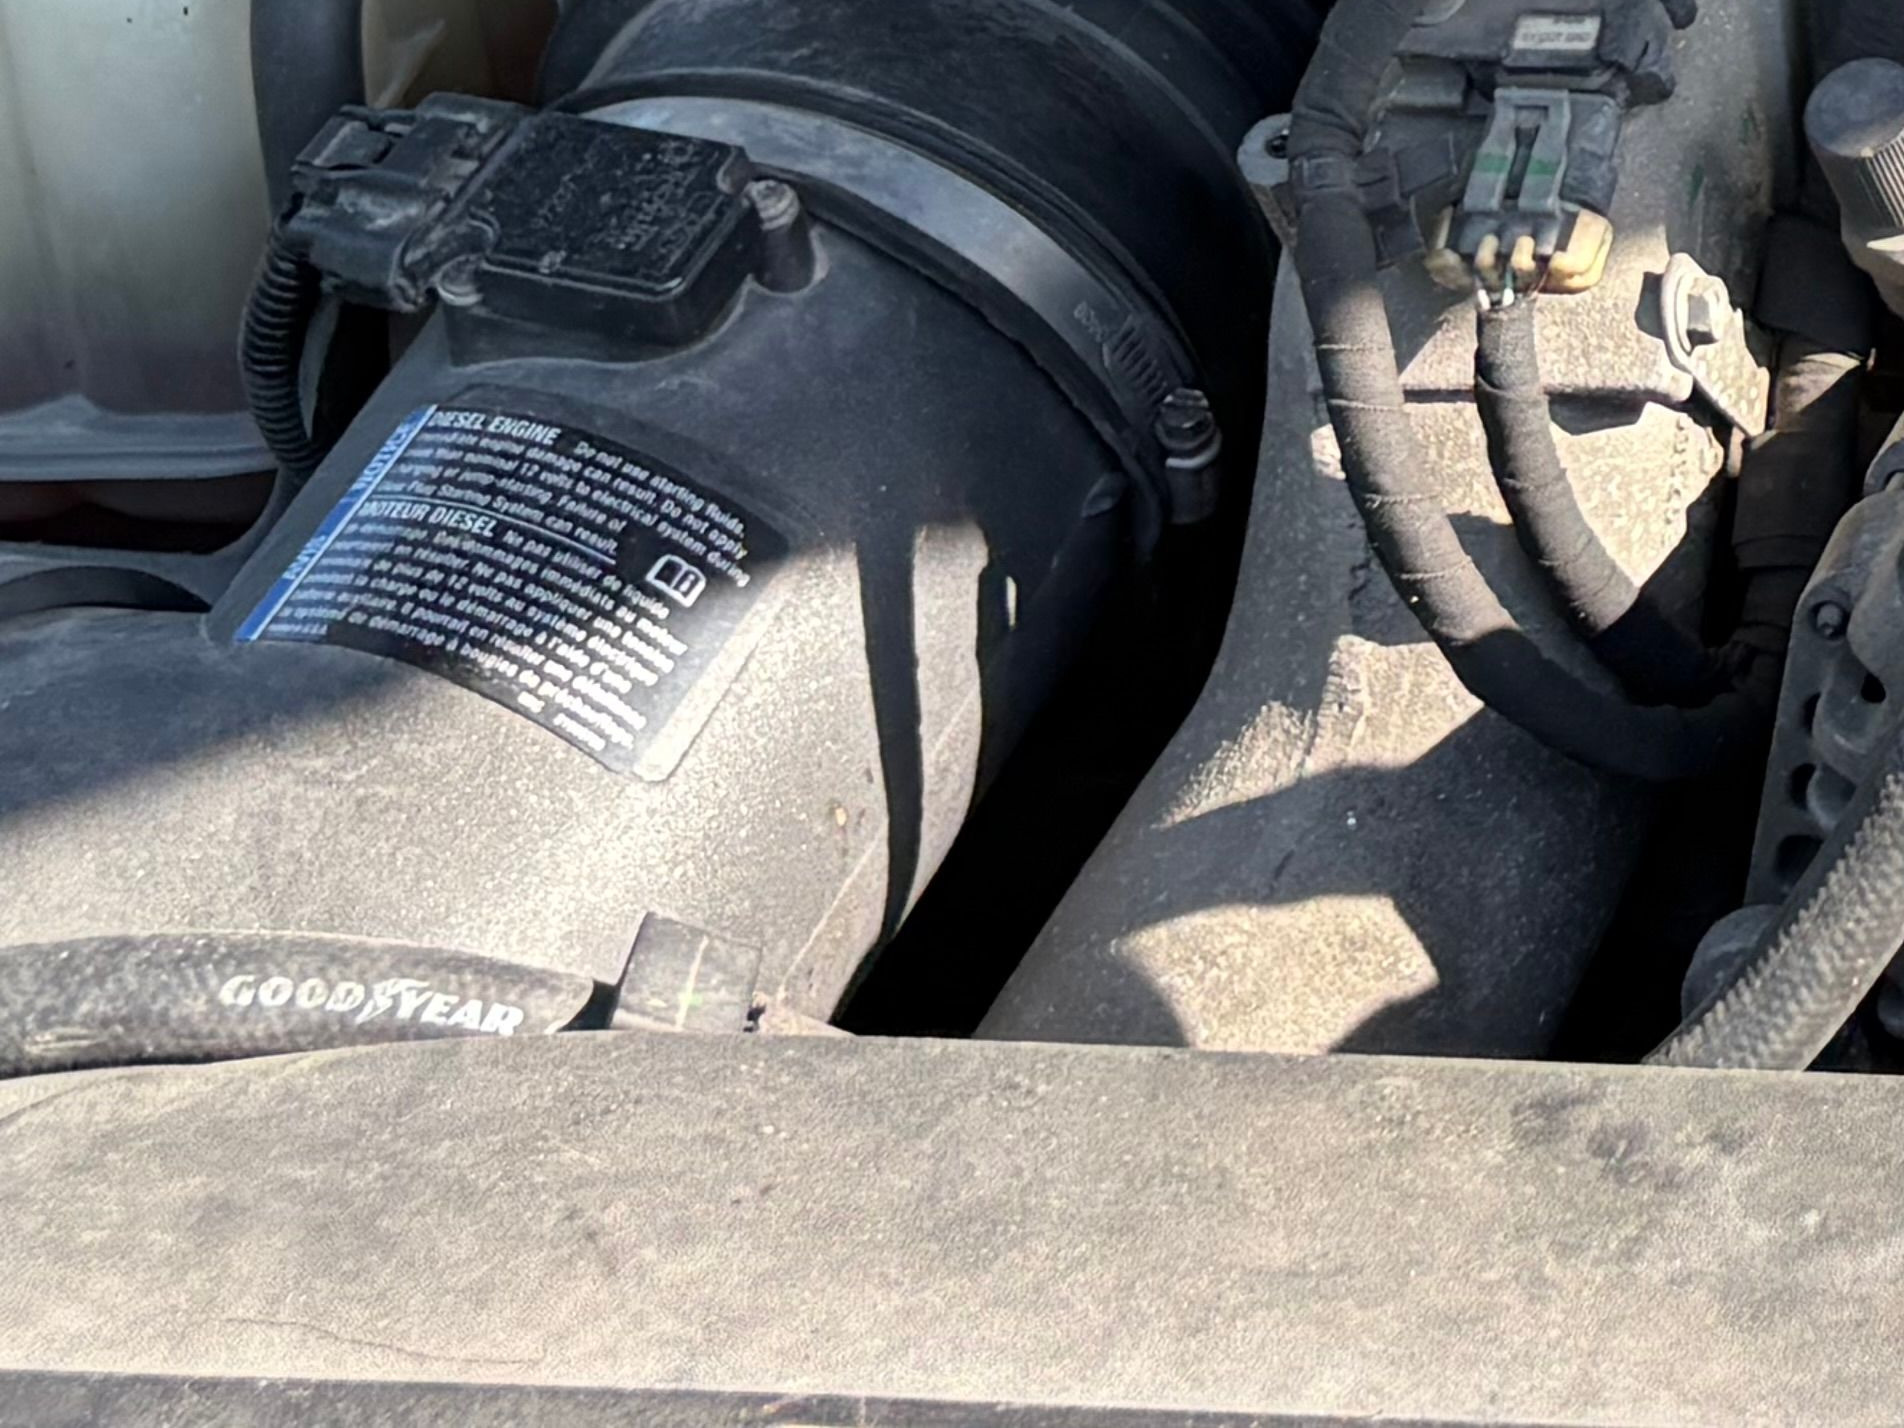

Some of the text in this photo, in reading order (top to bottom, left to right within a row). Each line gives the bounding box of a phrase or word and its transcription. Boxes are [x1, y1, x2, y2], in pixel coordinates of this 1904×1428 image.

[427, 409, 487, 428] DIESEL
[486, 416, 561, 443] ENGINE
[572, 440, 598, 458] Do
[594, 449, 624, 467] not
[620, 461, 650, 481] use
[647, 473, 706, 512] starting
[435, 483, 493, 505] Starting
[490, 495, 547, 519] System
[543, 514, 575, 532] can
[572, 524, 623, 554] result.
[457, 466, 554, 502] jump-starting.
[555, 493, 611, 523] Failure
[605, 516, 628, 531] of
[463, 450, 519, 470] nominal
[518, 461, 540, 476] 12
[537, 469, 575, 489] volts
[573, 480, 594, 494] to
[589, 485, 659, 527] electrical
[653, 521, 709, 555] system
[704, 546, 753, 588] during
[476, 437, 525, 454] engine
[524, 445, 582, 472] damage
[582, 465, 612, 481] can
[610, 475, 661, 506] result.
[657, 499, 684, 518] Do
[680, 511, 711, 532] not
[704, 526, 750, 561] apply
[356, 500, 672, 620] MOTEUR DIESEL Ne pas utiliser de liquide
[471, 559, 496, 577] Ne
[492, 571, 524, 588] pas
[522, 578, 596, 622] appliquer
[539, 562, 619, 610] immédiats
[614, 605, 639, 623] au
[367, 613, 448, 647] démarrage
[444, 635, 460, 651] à
[368, 575, 419, 596] charge
[417, 587, 441, 601] ou
[438, 591, 457, 607] le
[454, 594, 537, 639] démarrage
[532, 630, 550, 644] à
[391, 561, 425, 577] plus
[445, 573, 467, 589] 12
[465, 580, 506, 601] volts
[504, 594, 527, 611] au
[524, 602, 591, 641] système
[409, 605, 471, 628] pourrait
[468, 624, 490, 638] en
[486, 630, 549, 666] résulter
[218, 973, 525, 1036] GOODYEAR
